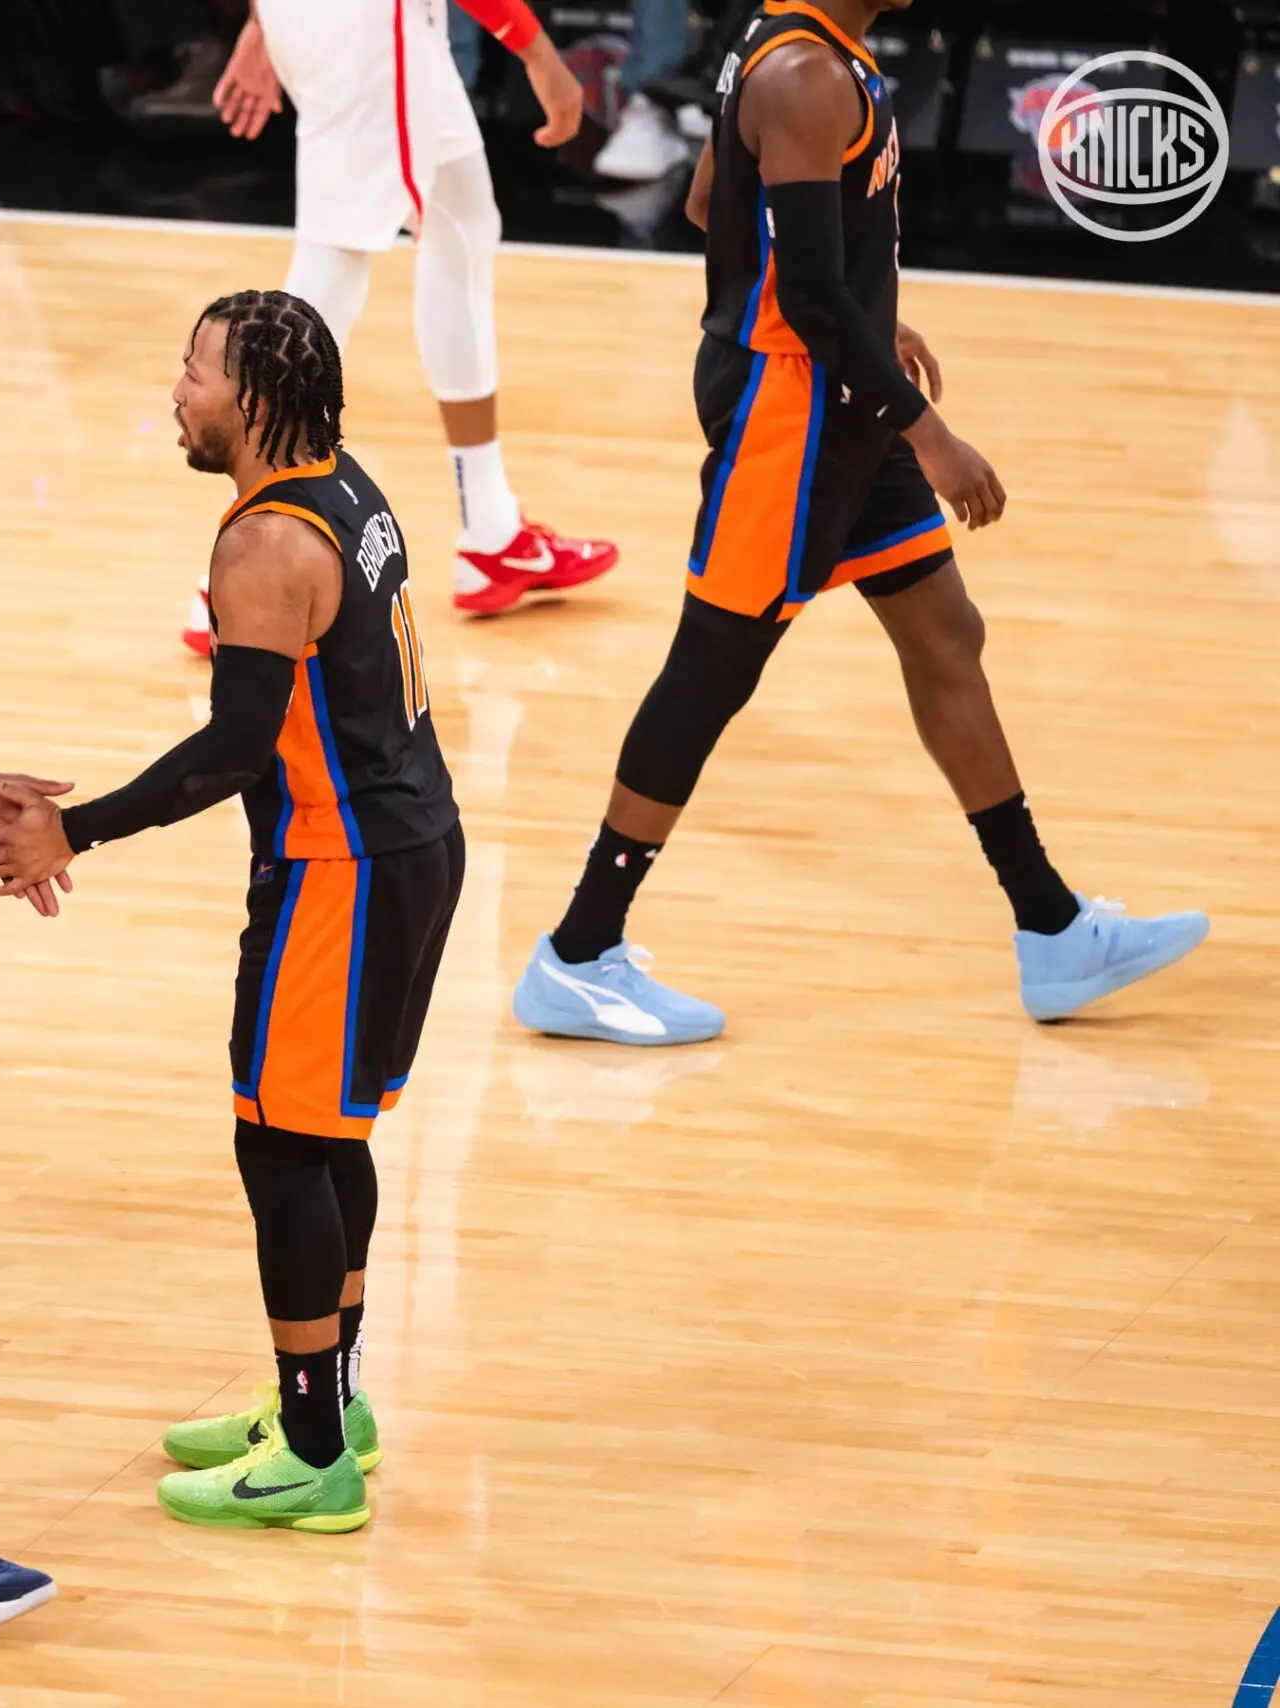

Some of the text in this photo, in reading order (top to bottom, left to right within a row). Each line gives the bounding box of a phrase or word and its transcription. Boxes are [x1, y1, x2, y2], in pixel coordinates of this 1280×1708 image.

[851, 59, 867, 81] 6
[866, 115, 900, 199] NE
[355, 510, 403, 593] BRUNSO
